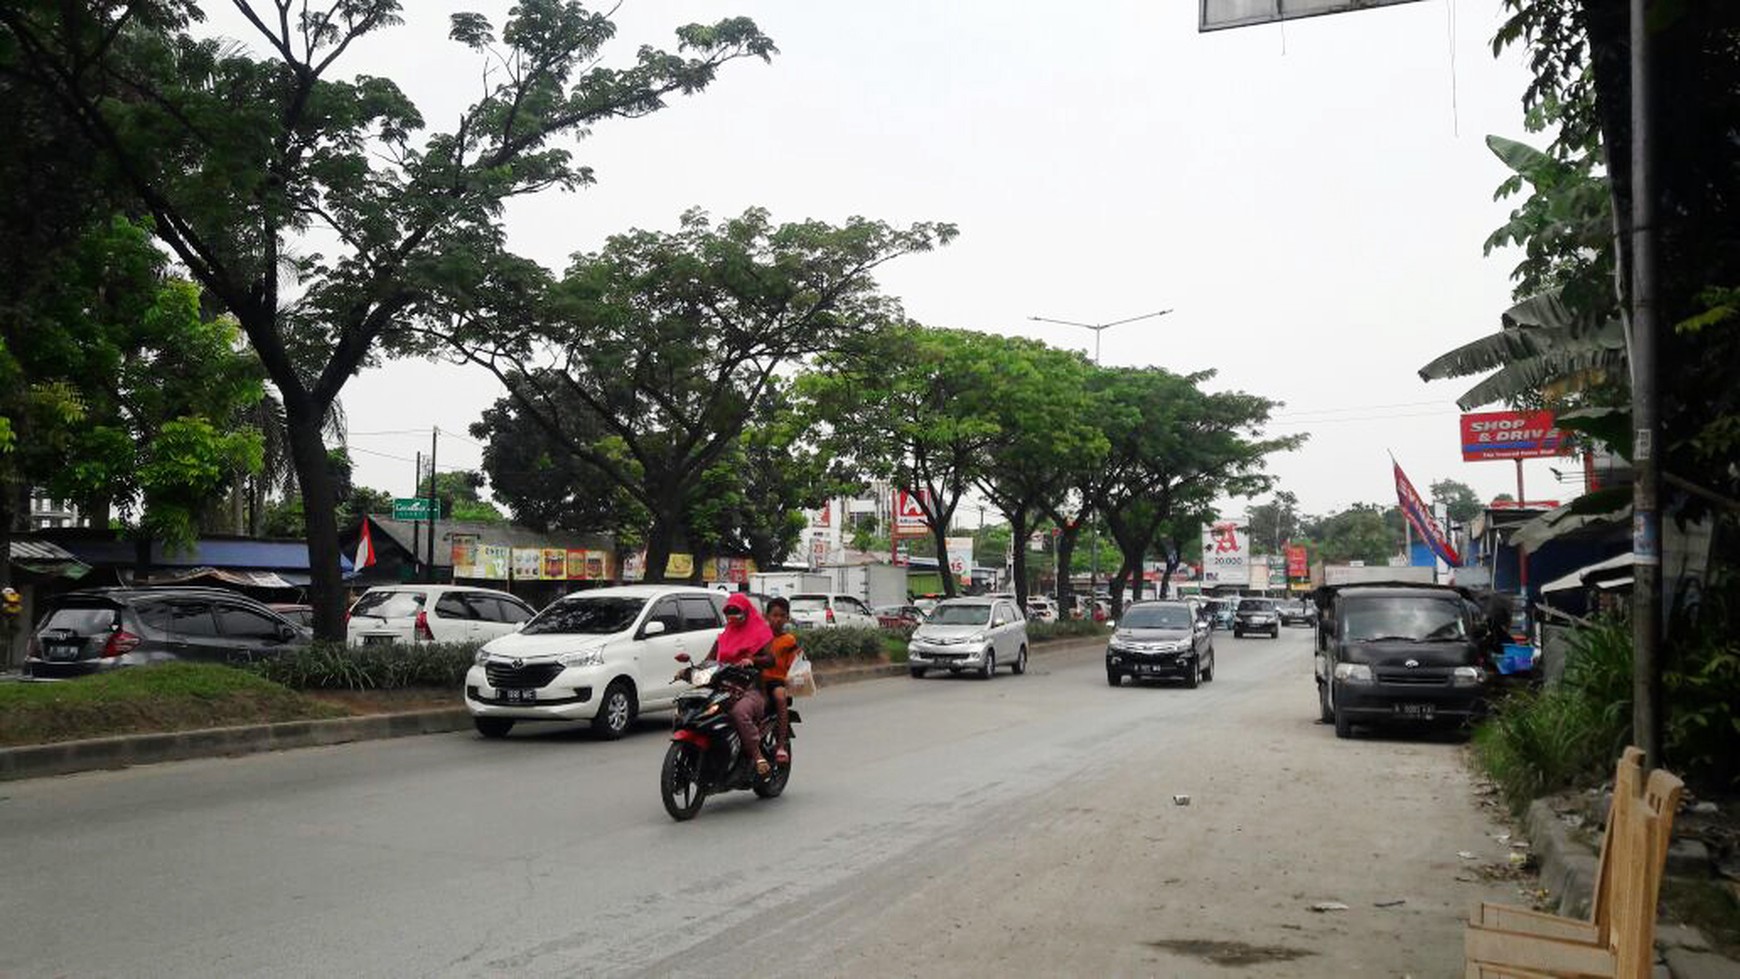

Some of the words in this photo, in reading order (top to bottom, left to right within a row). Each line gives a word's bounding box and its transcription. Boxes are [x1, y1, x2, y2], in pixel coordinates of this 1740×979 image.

[1471, 420, 1525, 432] SHOP
[1480, 432, 1492, 442] &
[1497, 428, 1560, 441] DRIVE
